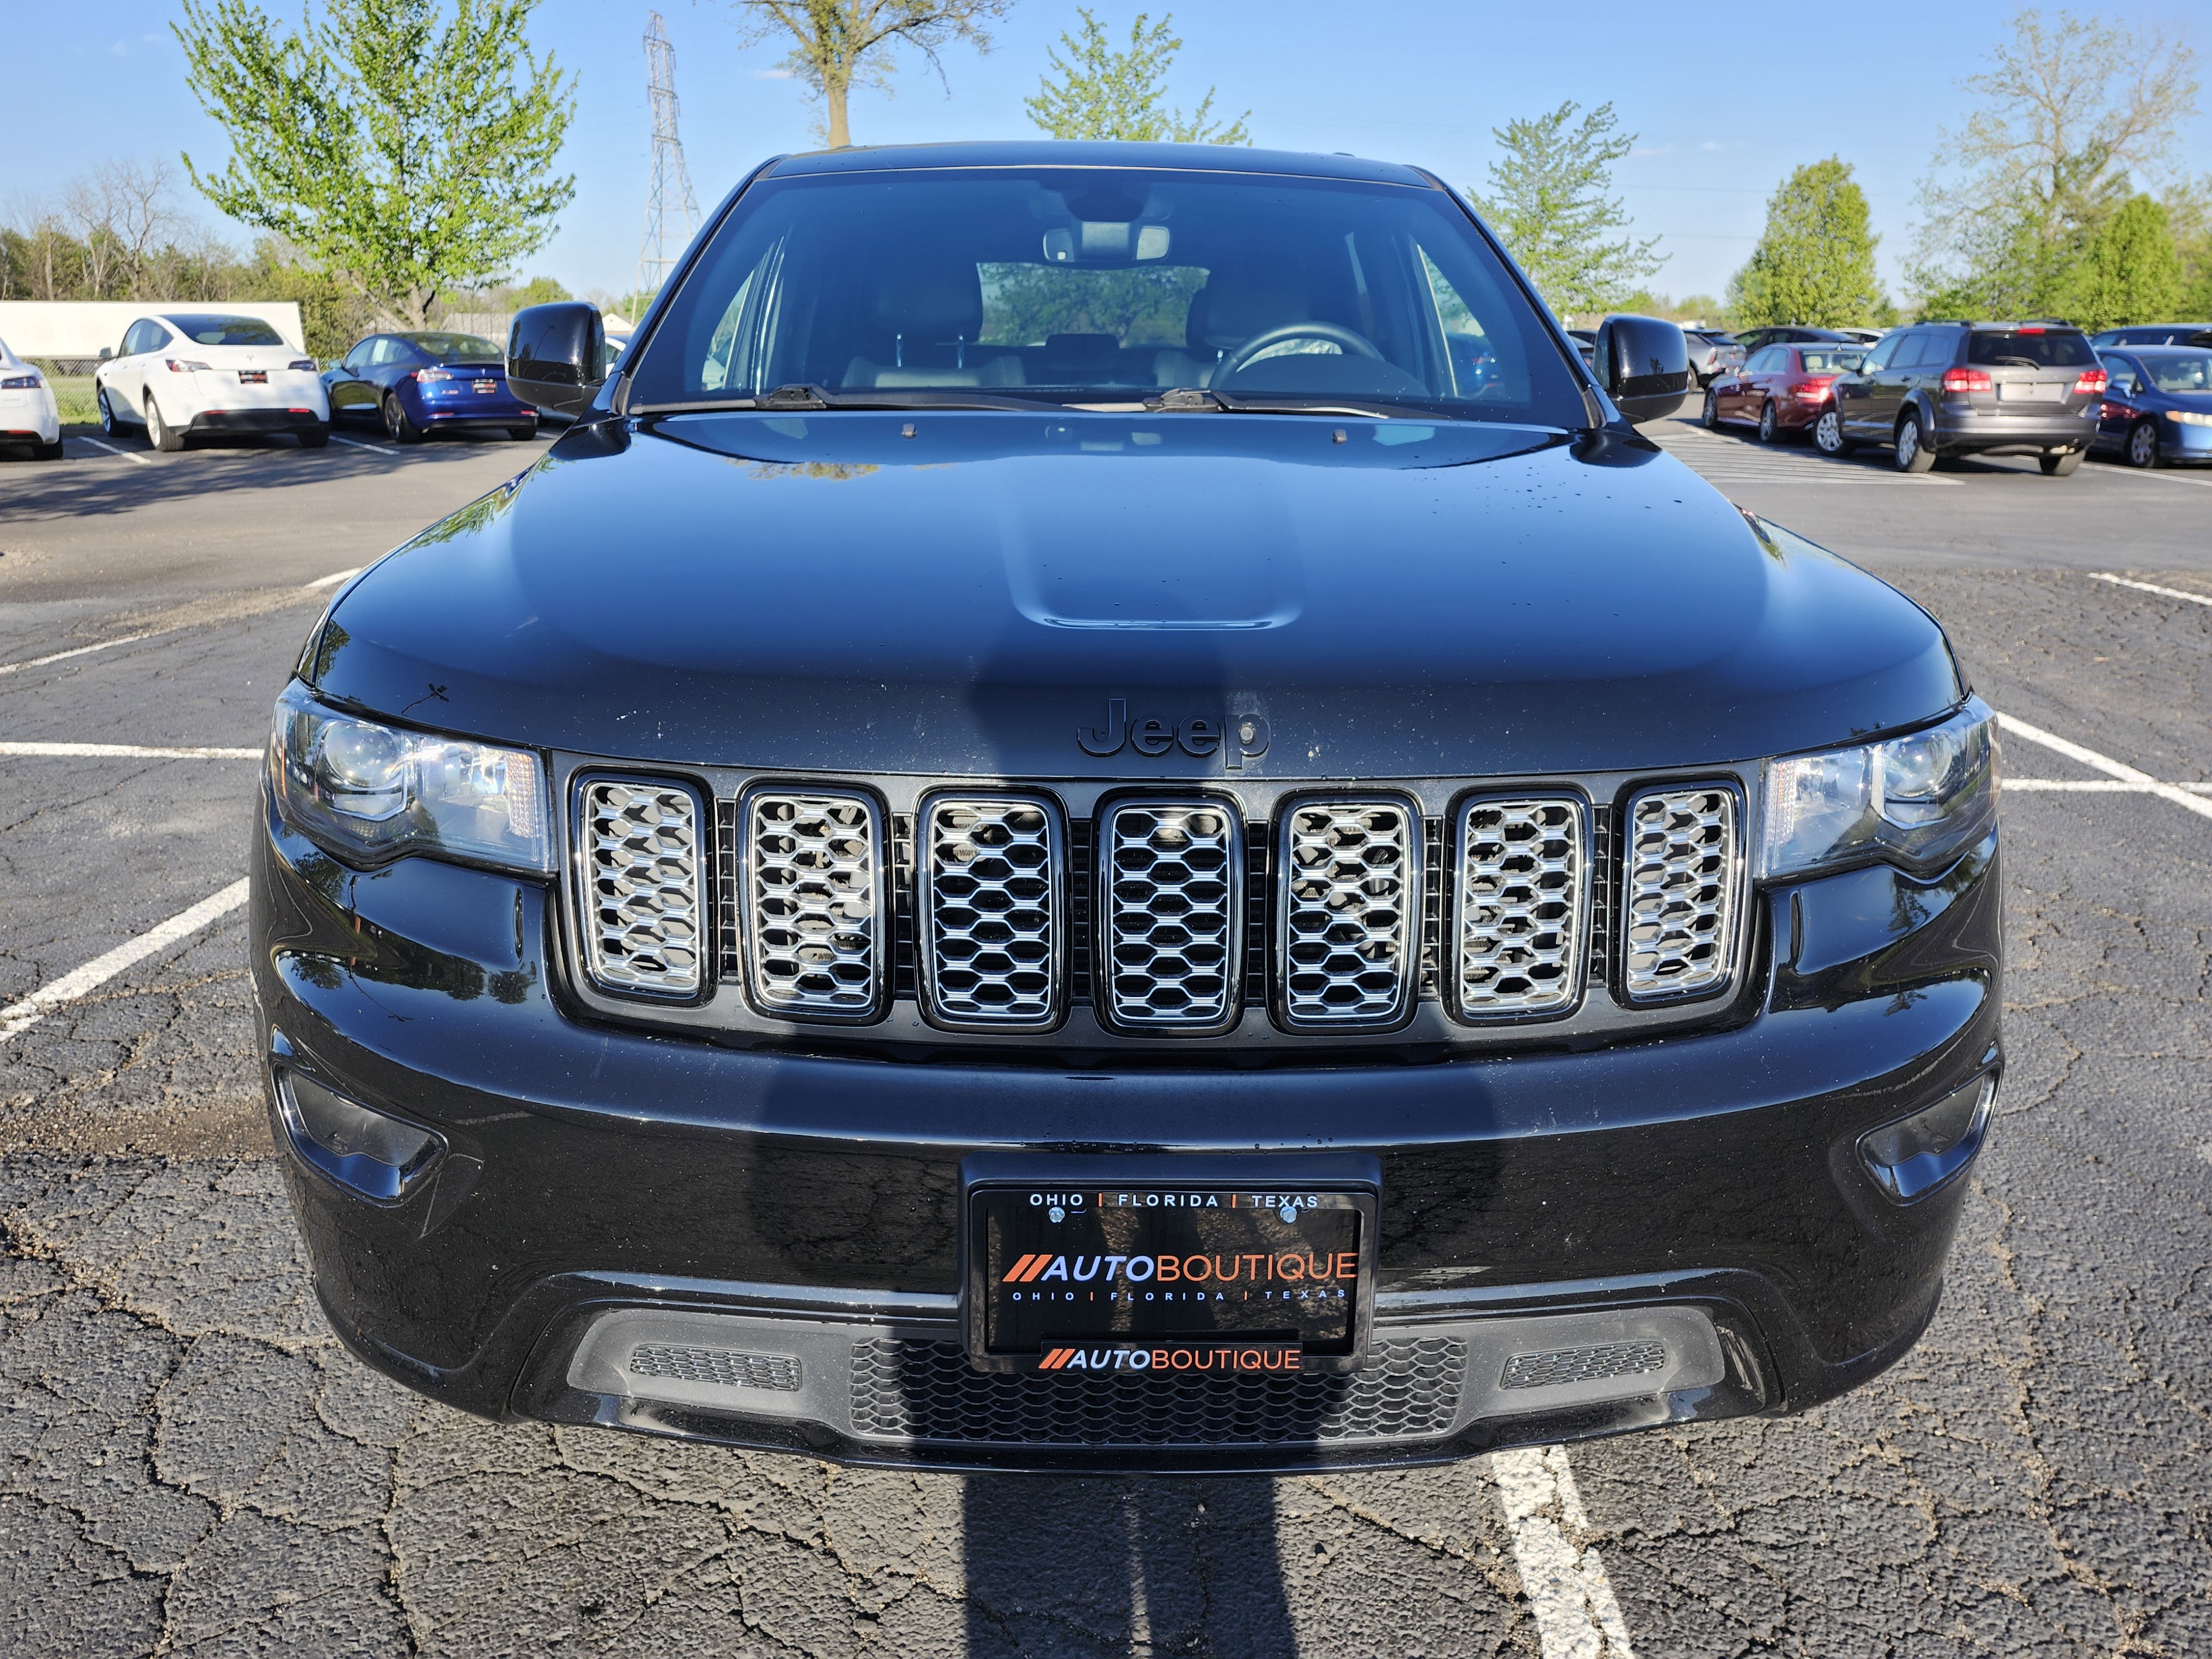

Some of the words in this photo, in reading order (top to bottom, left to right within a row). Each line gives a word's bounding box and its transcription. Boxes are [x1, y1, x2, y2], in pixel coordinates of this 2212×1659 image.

[1077, 698, 1271, 770] Jeep
[1030, 1194, 1083, 1206] OHIO
[1118, 1194, 1218, 1207] FLORIDA
[1251, 1196, 1318, 1208] TEXAS
[1041, 1253, 1358, 1281] AUTOBOUTIQUE
[1265, 1290, 1345, 1299] TEXAS
[1067, 1350, 1300, 1369] AUTOBOUTIQUE
